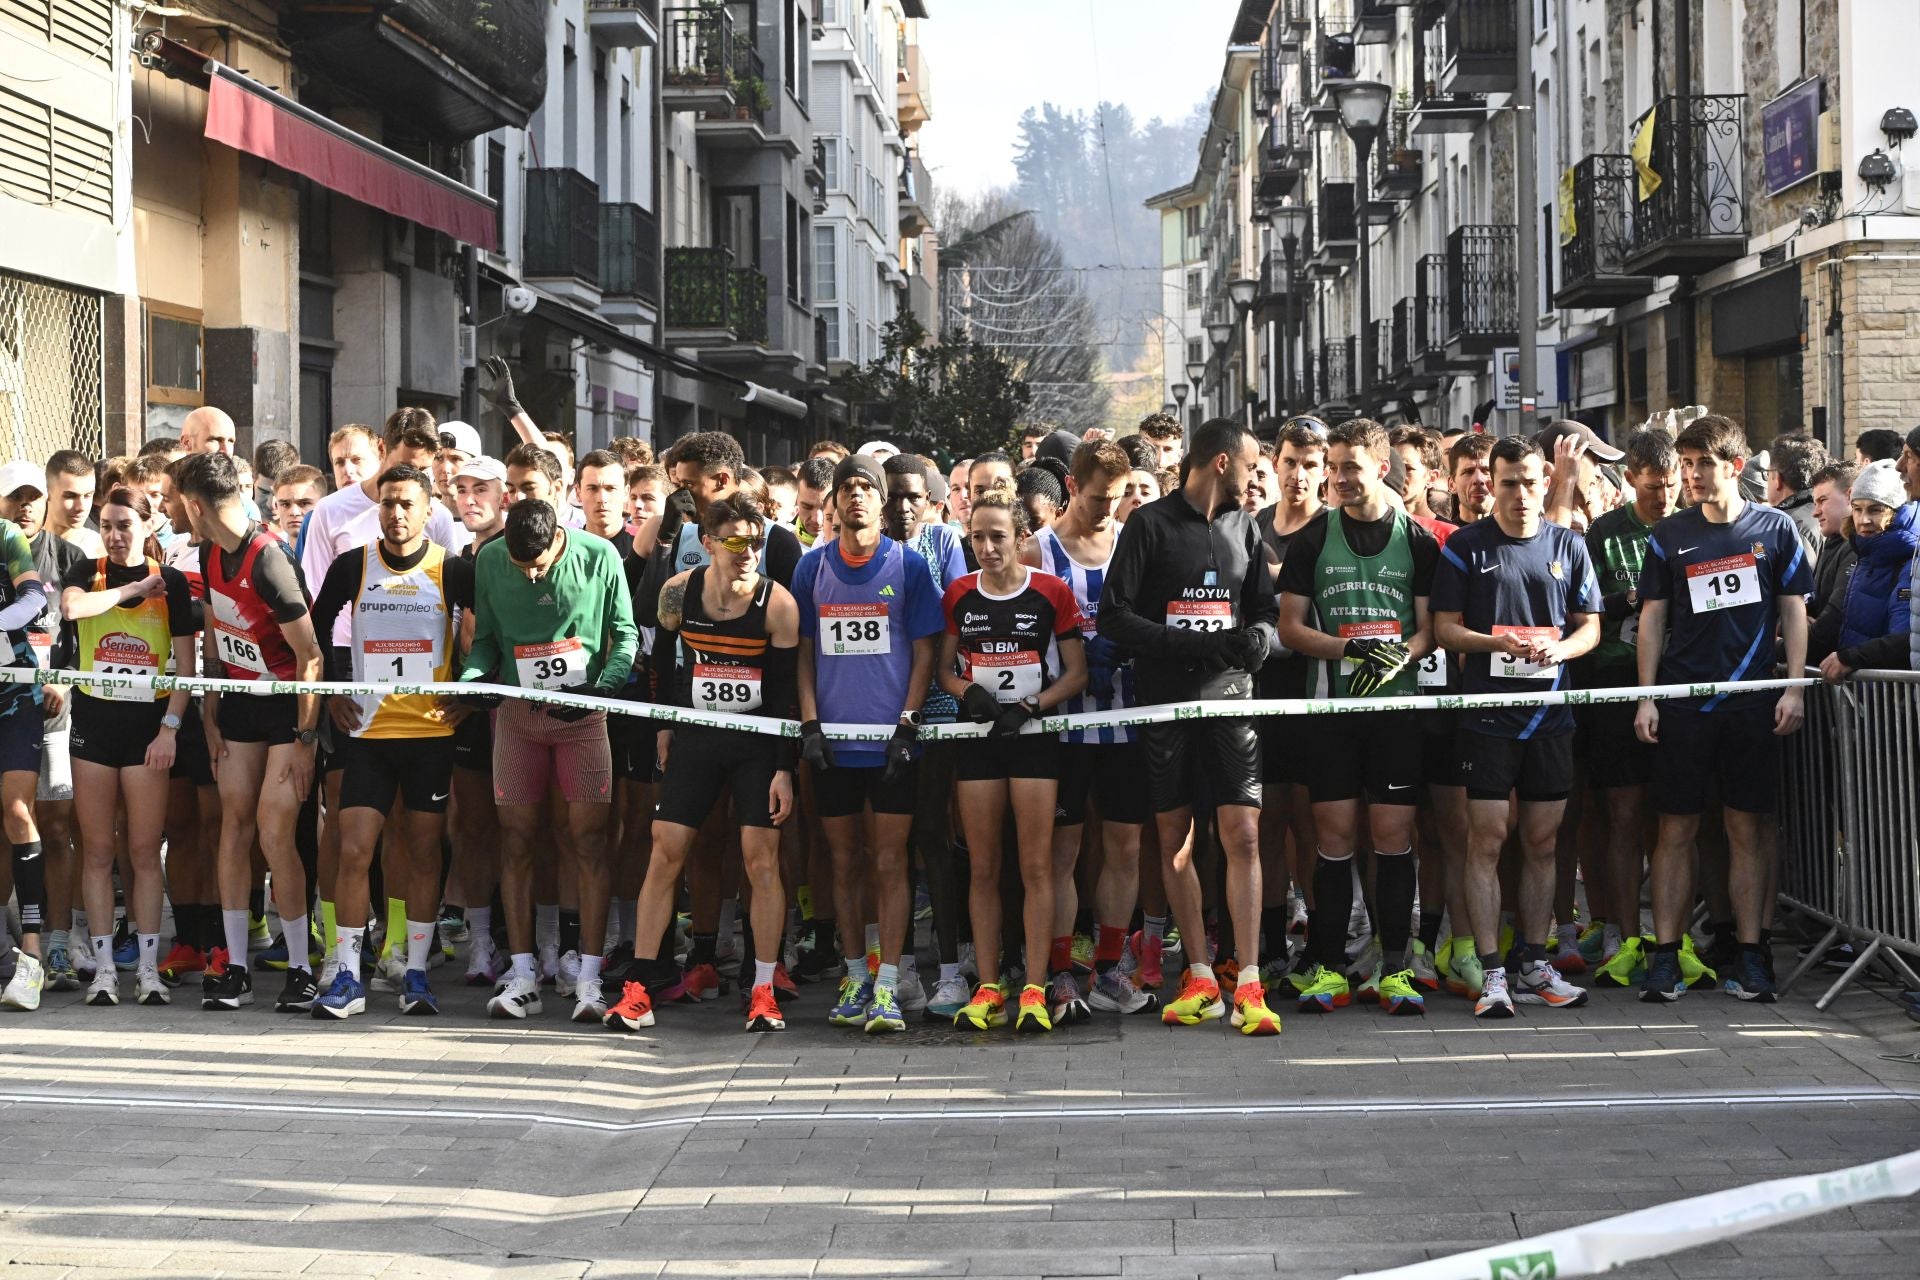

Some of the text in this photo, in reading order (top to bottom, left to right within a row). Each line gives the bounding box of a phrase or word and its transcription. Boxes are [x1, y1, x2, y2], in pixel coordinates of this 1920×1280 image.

[1182, 587, 1230, 599] MOYUA
[1322, 581, 1404, 603] GOIERRI GARAIA
[1708, 573, 1741, 597] 19
[359, 602, 431, 615] grupompleo
[1329, 606, 1398, 618] ATLETISMO
[830, 620, 881, 641] 138
[104, 637, 146, 653] Serrano
[223, 635, 257, 662] 166
[995, 641, 1019, 653] BM
[391, 656, 403, 677] 1
[533, 657, 568, 680] 39
[997, 670, 1016, 691] 2
[701, 681, 751, 703] 389
